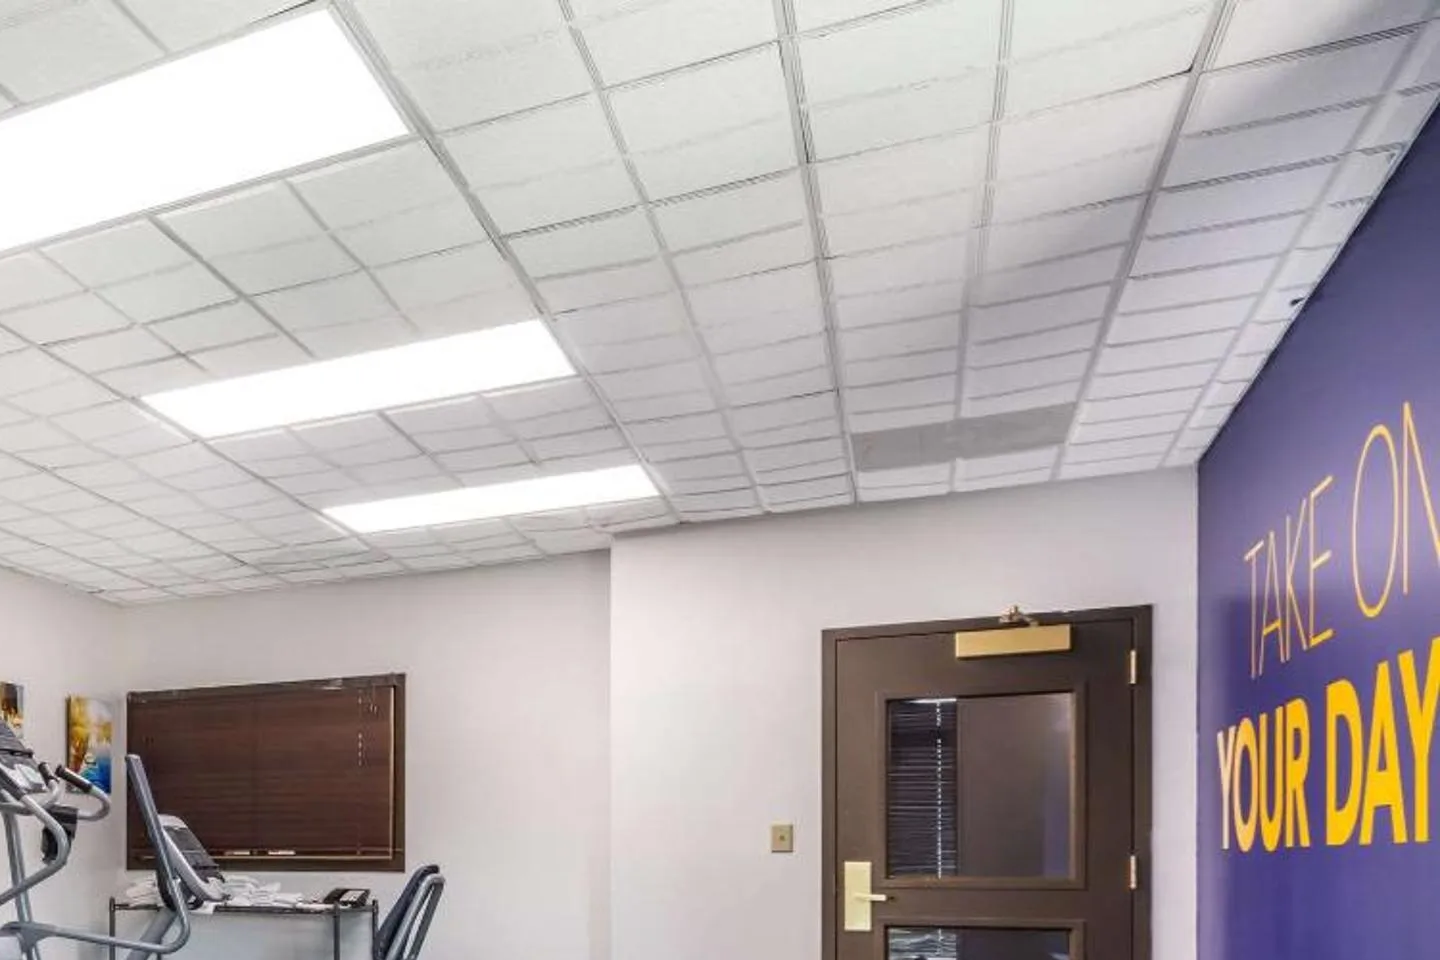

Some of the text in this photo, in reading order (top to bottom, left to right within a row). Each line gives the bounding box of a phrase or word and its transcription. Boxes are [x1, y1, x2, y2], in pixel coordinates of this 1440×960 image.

[1244, 401, 1440, 680] TAKE ON
[1217, 637, 1440, 853] YOUR DAY
